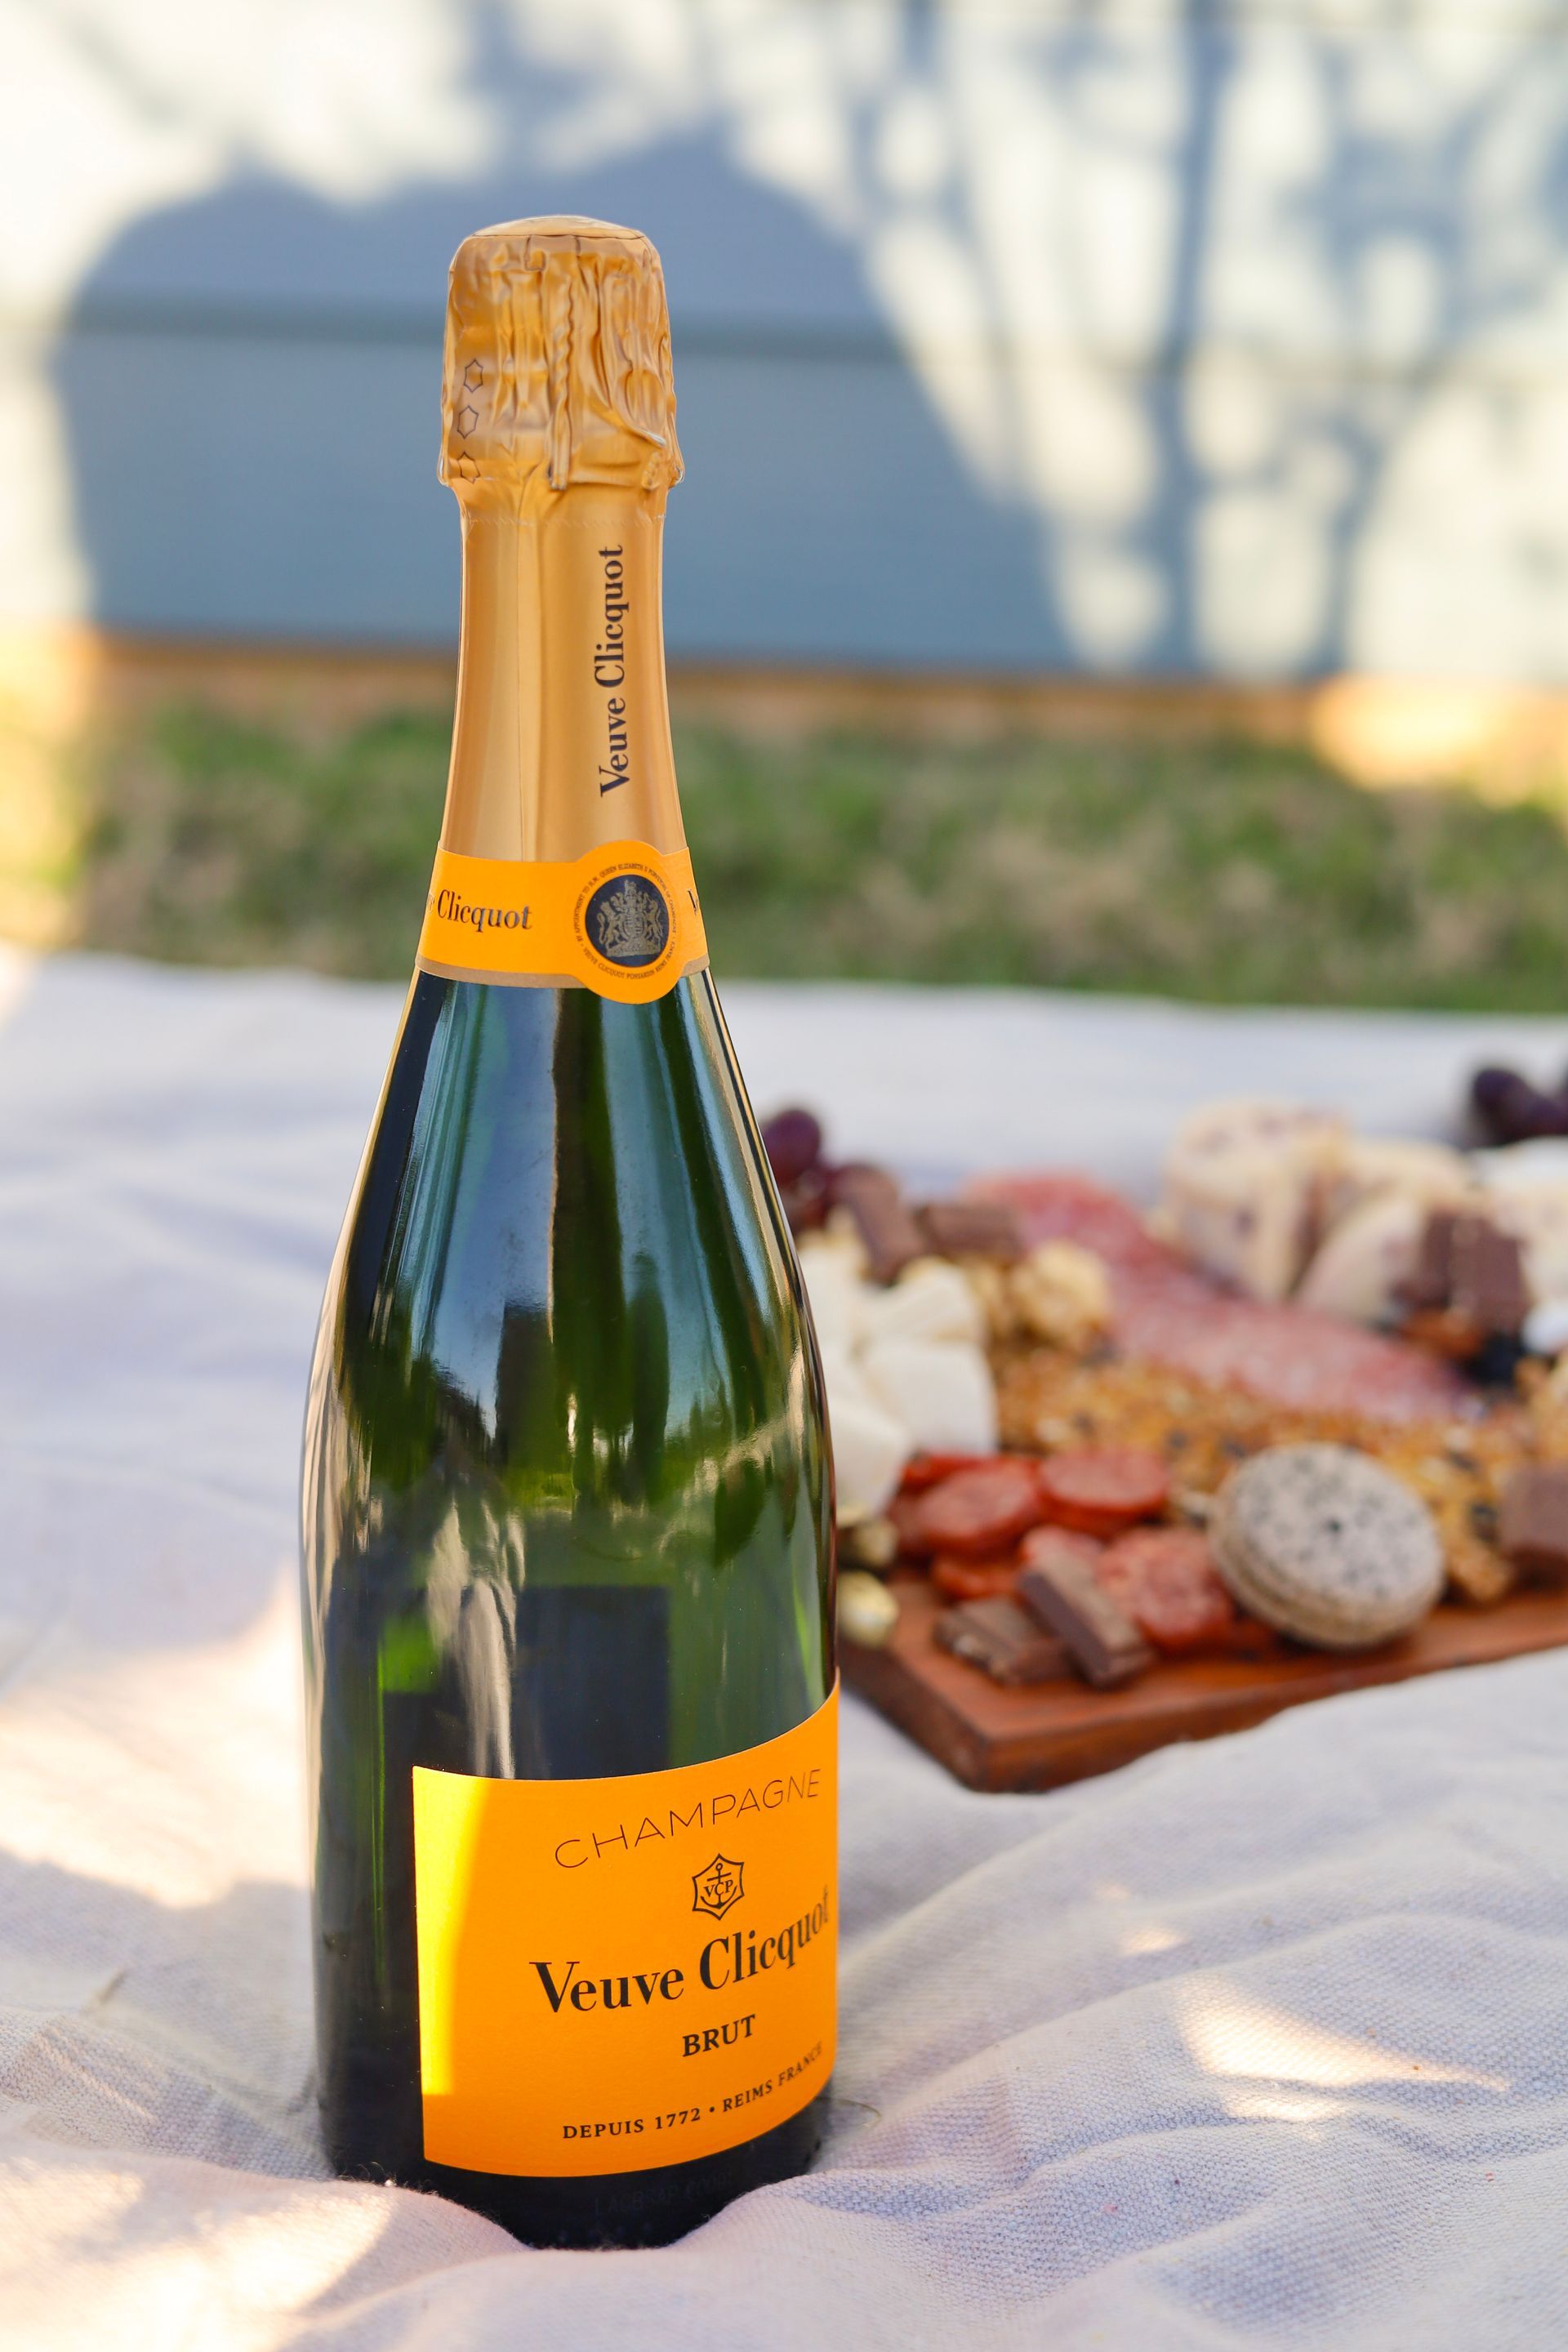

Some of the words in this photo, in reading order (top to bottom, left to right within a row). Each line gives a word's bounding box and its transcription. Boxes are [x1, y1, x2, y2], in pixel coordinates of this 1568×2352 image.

[594, 544, 630, 688] Clicquot
[598, 697, 630, 798] Veuve
[438, 889, 532, 933] Clicquot
[555, 1769, 821, 1869] CHAMPAGNE
[703, 1879, 734, 1898] VCP
[528, 1960, 684, 2013] Veuve
[699, 1884, 829, 1990] Clicquot
[682, 2014, 756, 2057] BRUT
[563, 2117, 645, 2140] DEPUIS
[654, 2106, 702, 2132] 1772
[723, 2078, 773, 2114] REIMS
[777, 2041, 822, 2086] FRANCE
